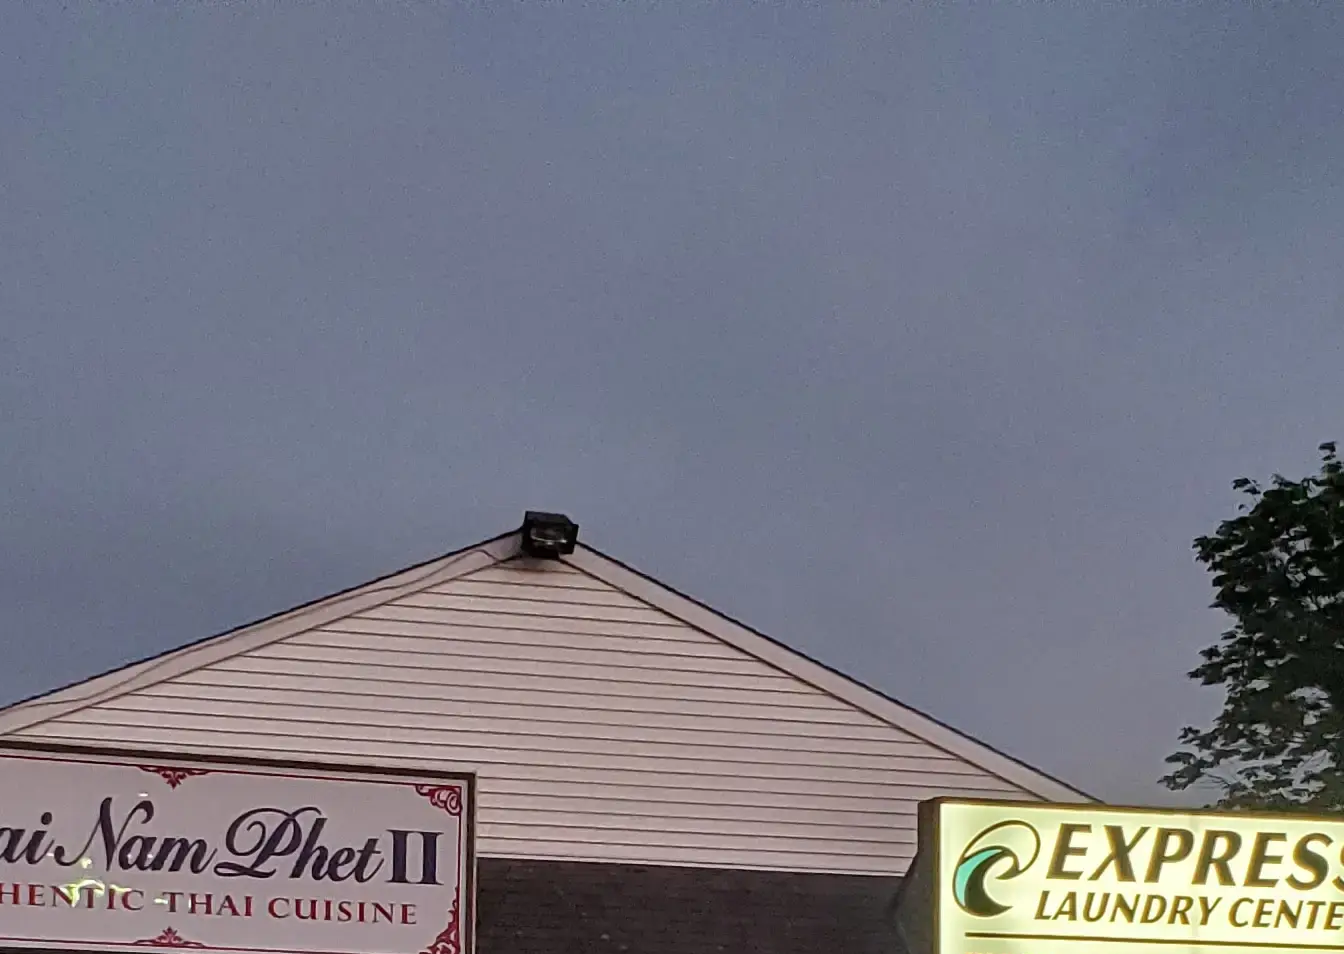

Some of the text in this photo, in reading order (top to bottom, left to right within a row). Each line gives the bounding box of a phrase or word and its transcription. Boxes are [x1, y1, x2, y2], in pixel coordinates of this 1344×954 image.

[53, 796, 218, 875] Nam
[213, 805, 385, 884] Phet
[388, 828, 445, 887] II
[163, 891, 254, 918] THAI
[267, 896, 419, 926] CUISINE
[1033, 889, 1217, 928] LAUNDRY
